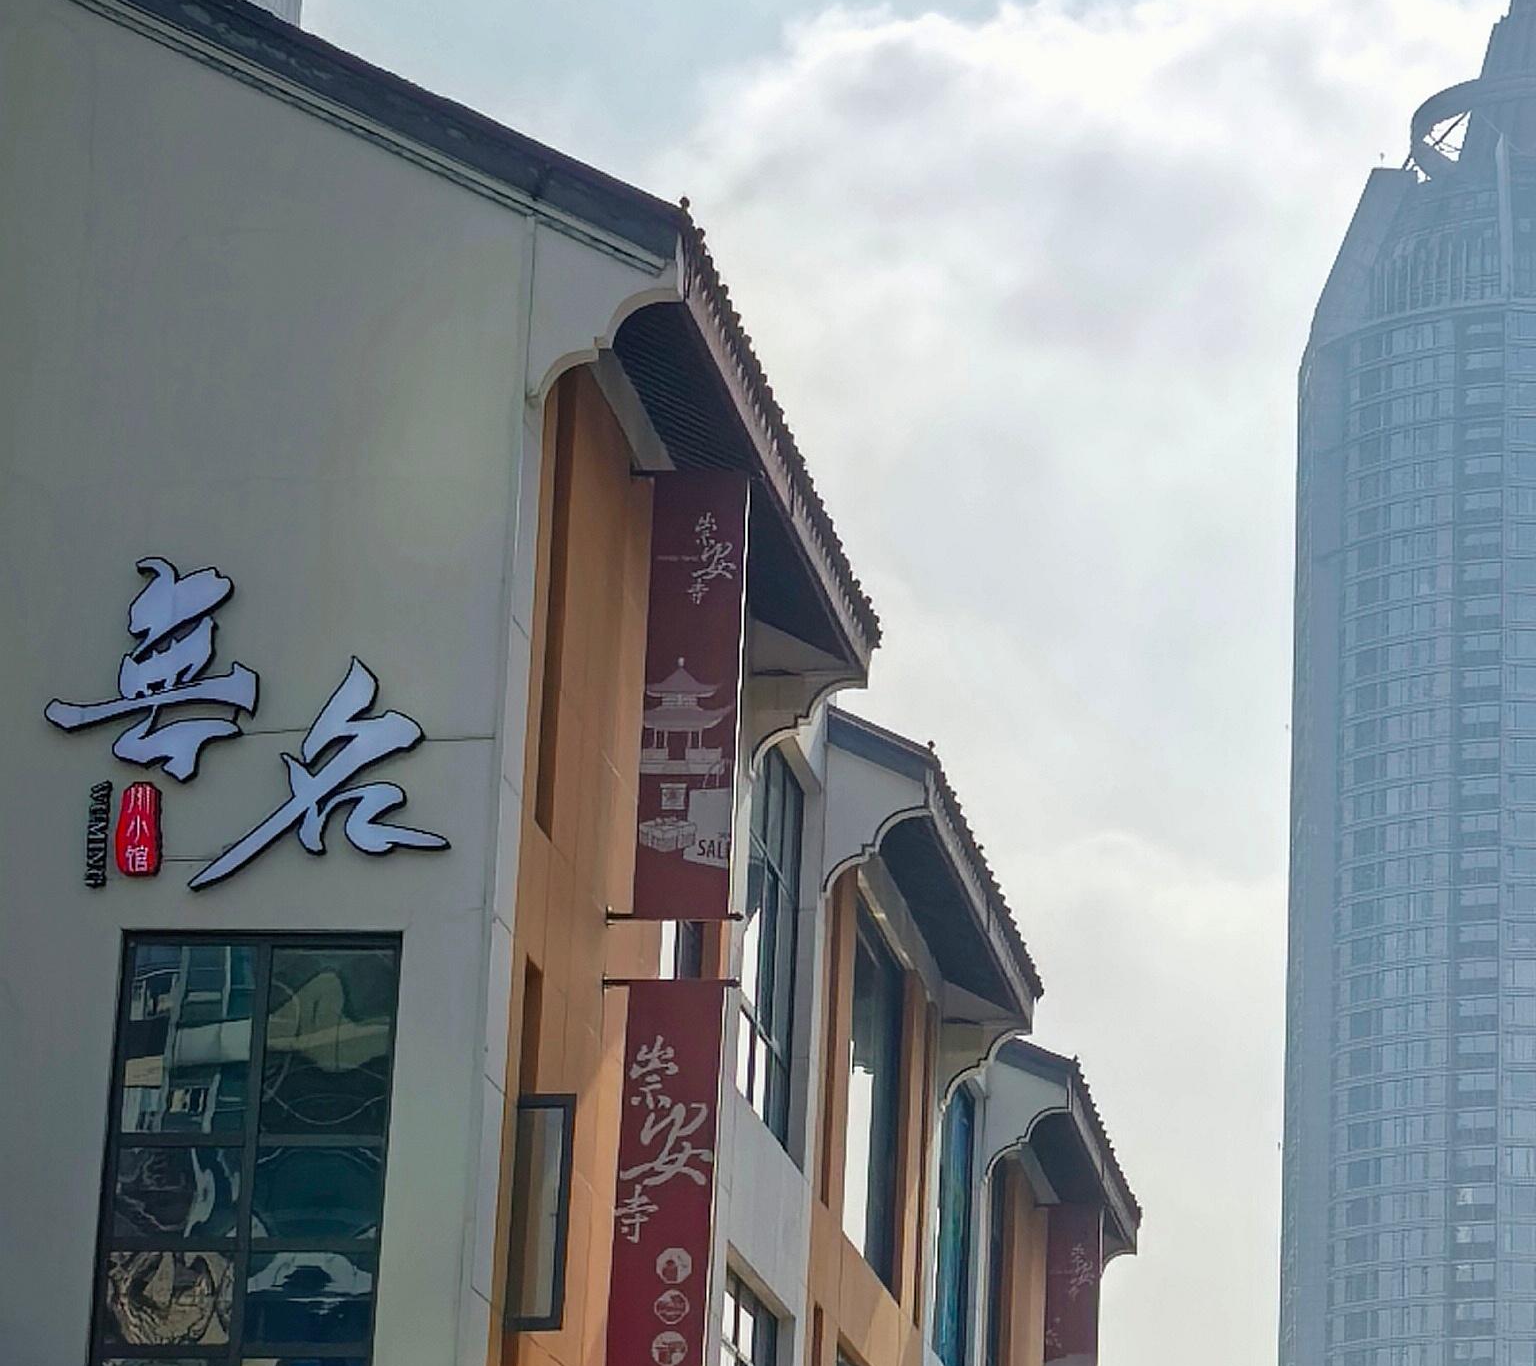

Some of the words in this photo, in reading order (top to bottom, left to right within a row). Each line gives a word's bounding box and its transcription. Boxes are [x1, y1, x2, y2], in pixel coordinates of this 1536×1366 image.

[125, 785, 150, 873] 川小馆
[697, 839, 728, 860] SAL
[616, 1035, 713, 1243] 崇安寺
